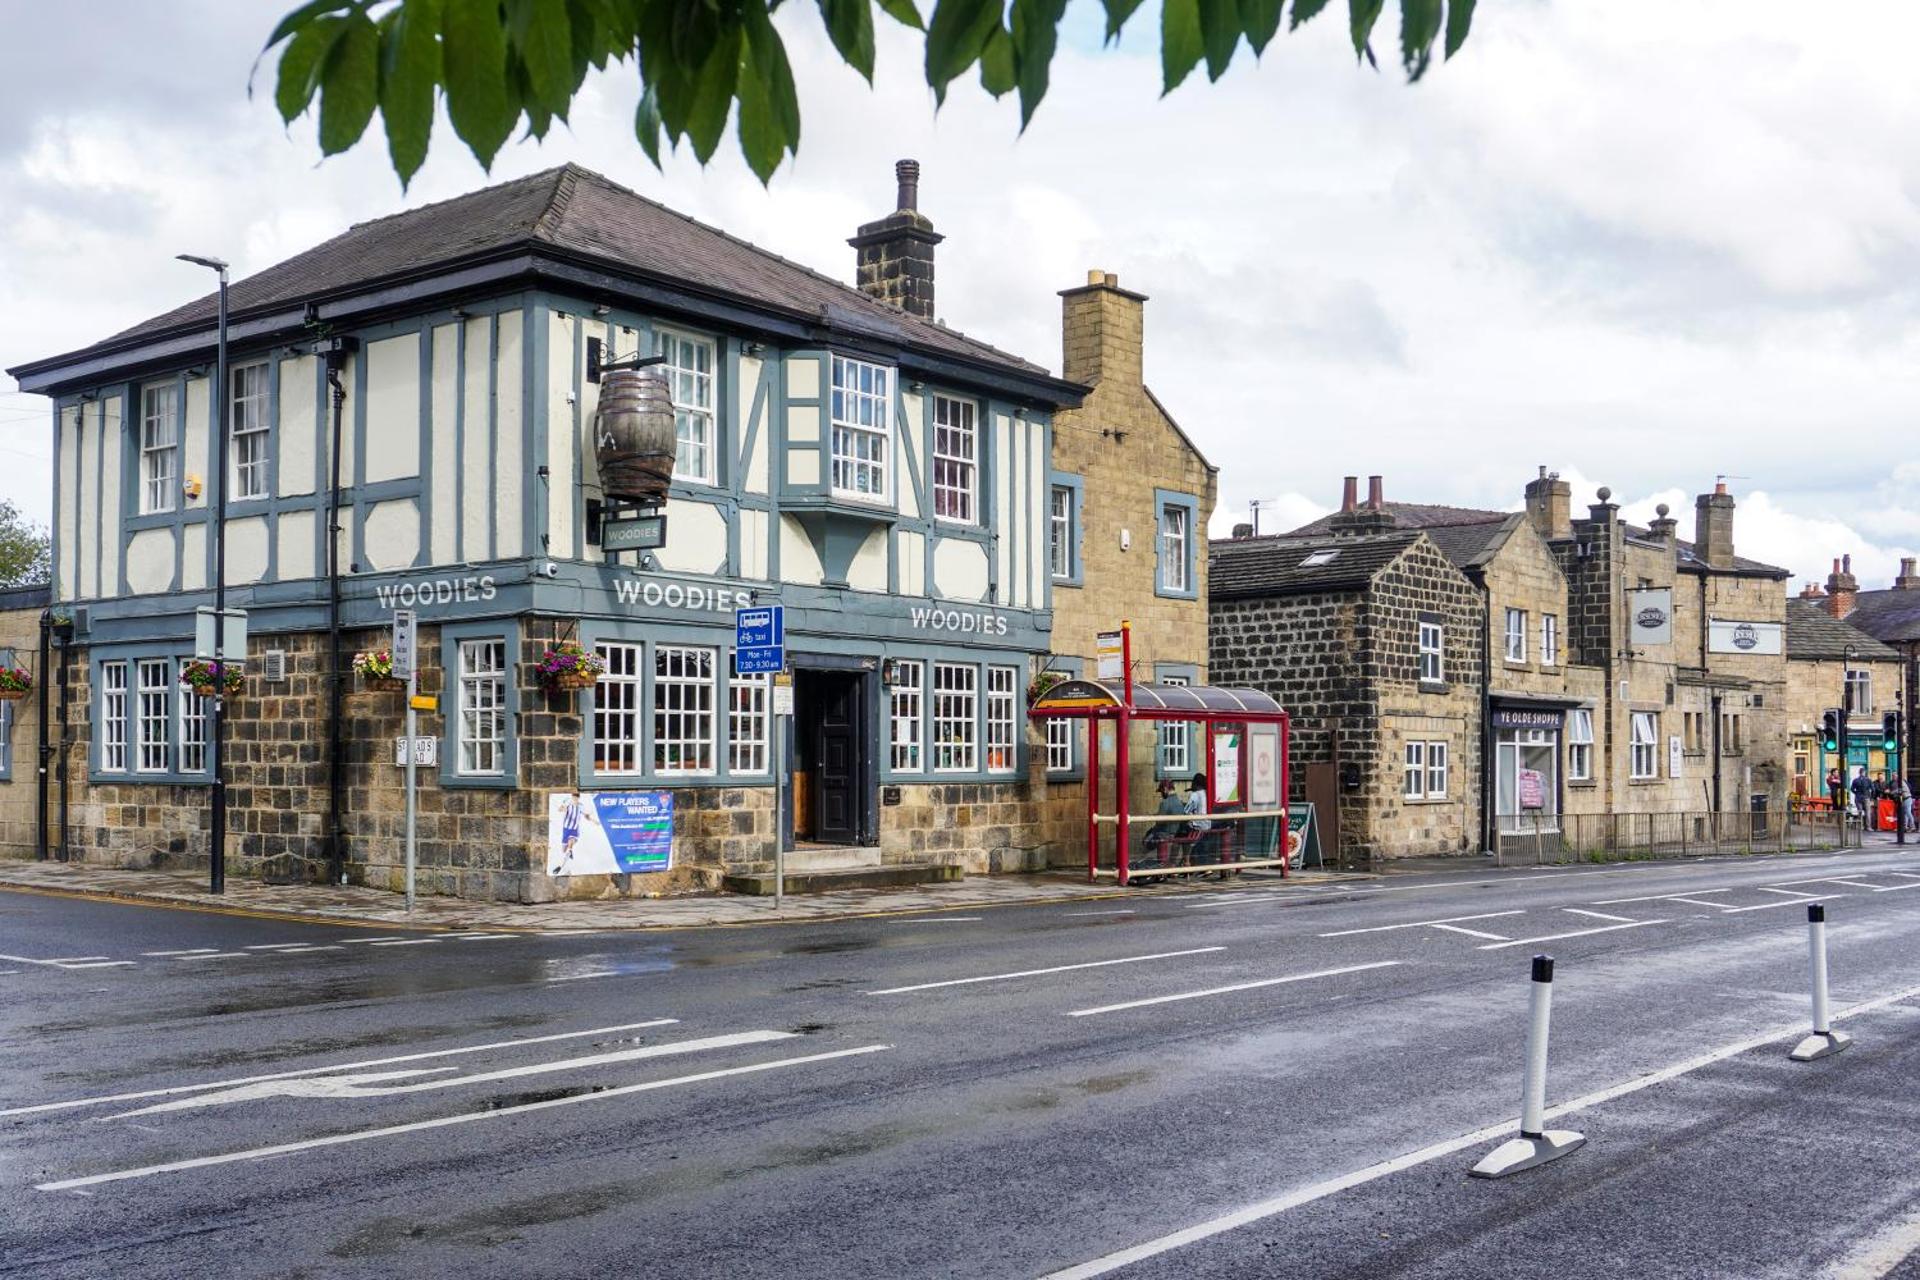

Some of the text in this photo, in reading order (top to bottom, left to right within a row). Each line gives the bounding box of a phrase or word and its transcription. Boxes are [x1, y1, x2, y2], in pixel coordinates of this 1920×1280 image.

[608, 527, 659, 541] WOODIES
[376, 575, 497, 609] WOODIES
[613, 579, 751, 613] WOODIES
[911, 607, 1007, 636] WOODIES
[754, 633, 766, 641] taxi
[1501, 711, 1559, 725] YE OLDE SHOPPE
[600, 797, 650, 807] NEW PLAYERS
[627, 805, 658, 815] WANTED
